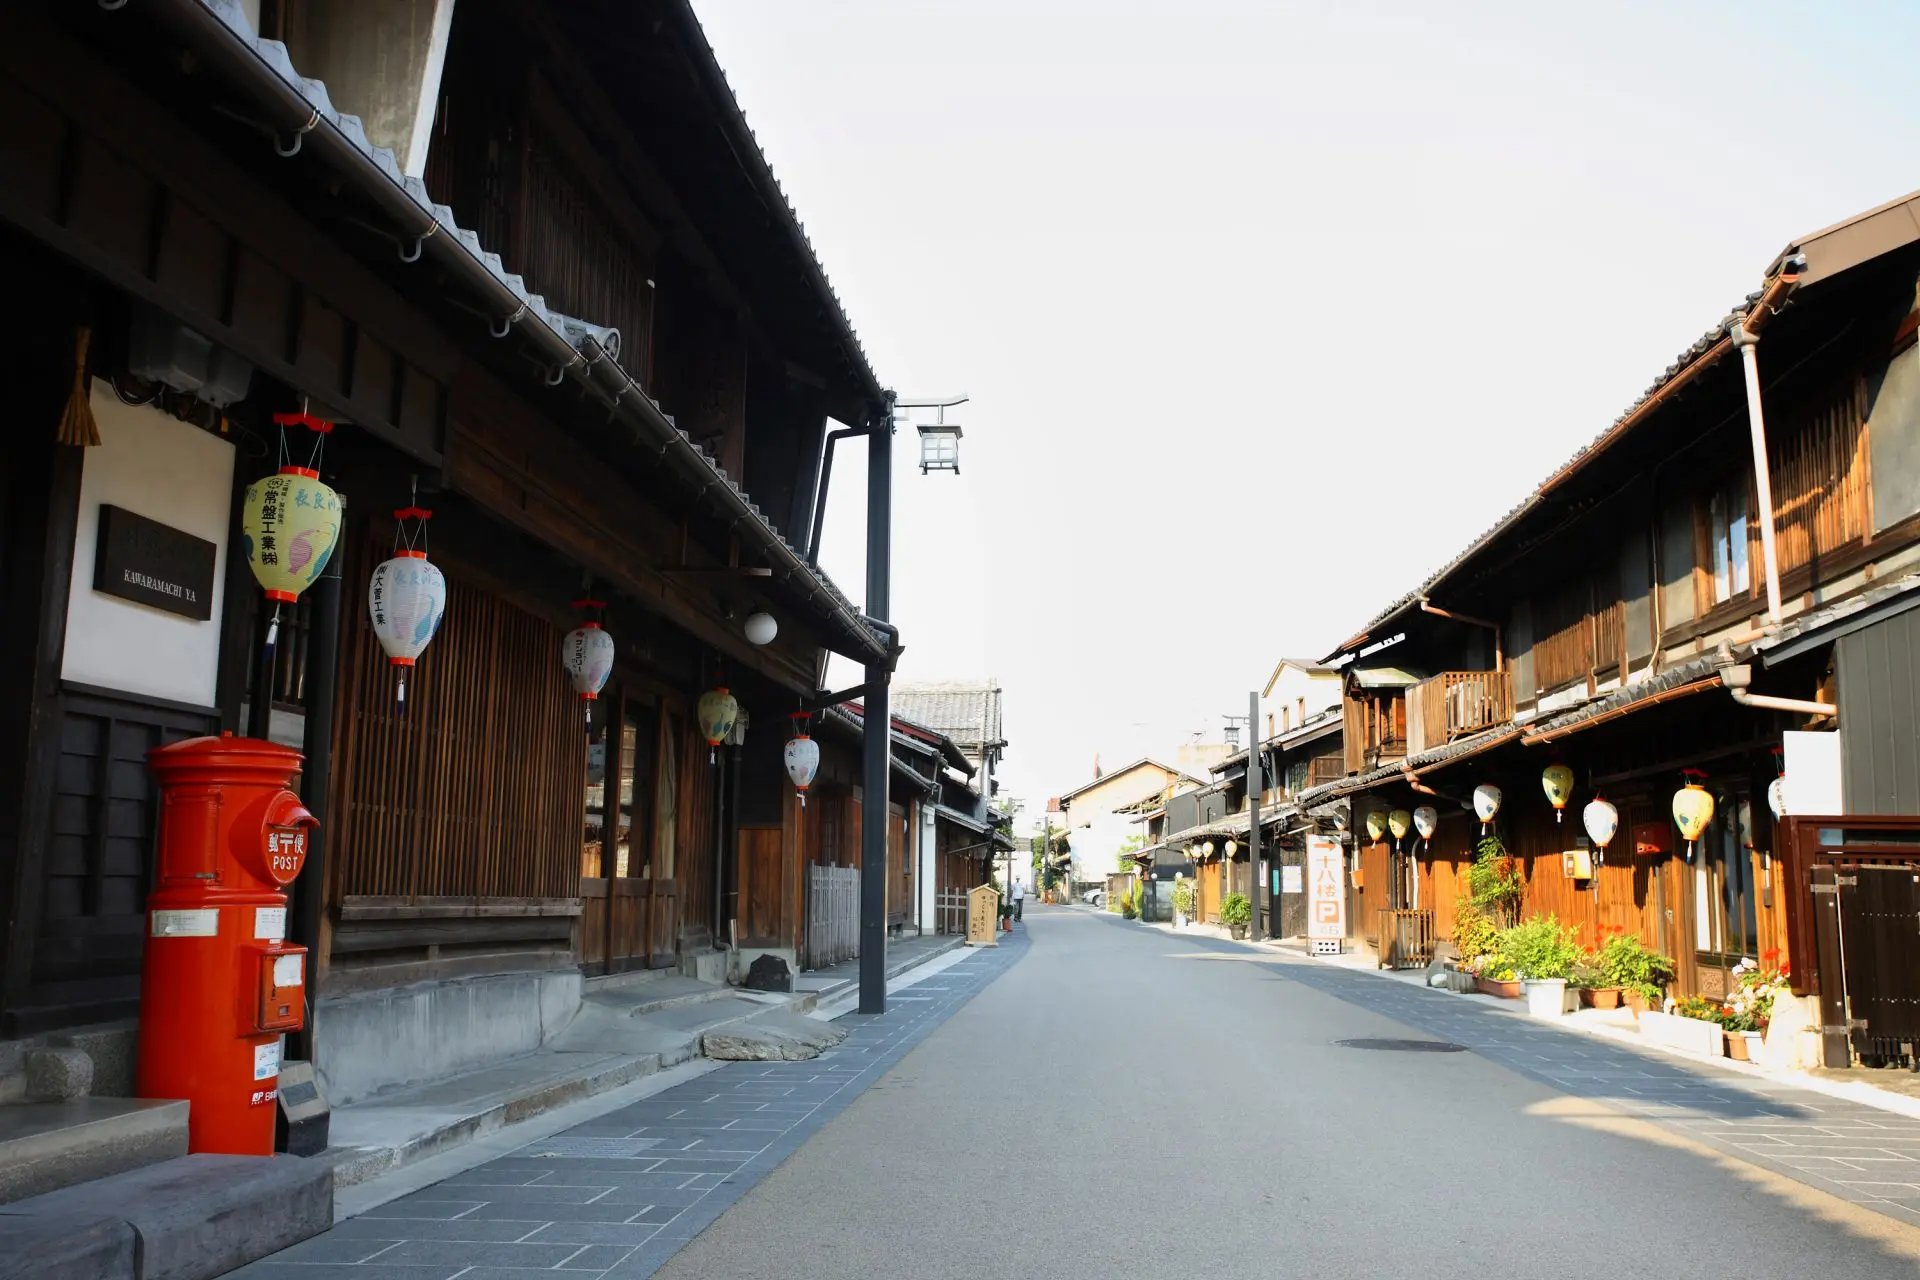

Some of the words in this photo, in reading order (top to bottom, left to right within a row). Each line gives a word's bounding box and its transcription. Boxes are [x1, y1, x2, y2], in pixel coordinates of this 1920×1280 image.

[123, 569, 183, 598] KAWARAMACHI
[186, 588, 197, 602] YA
[273, 855, 298, 870] POST
